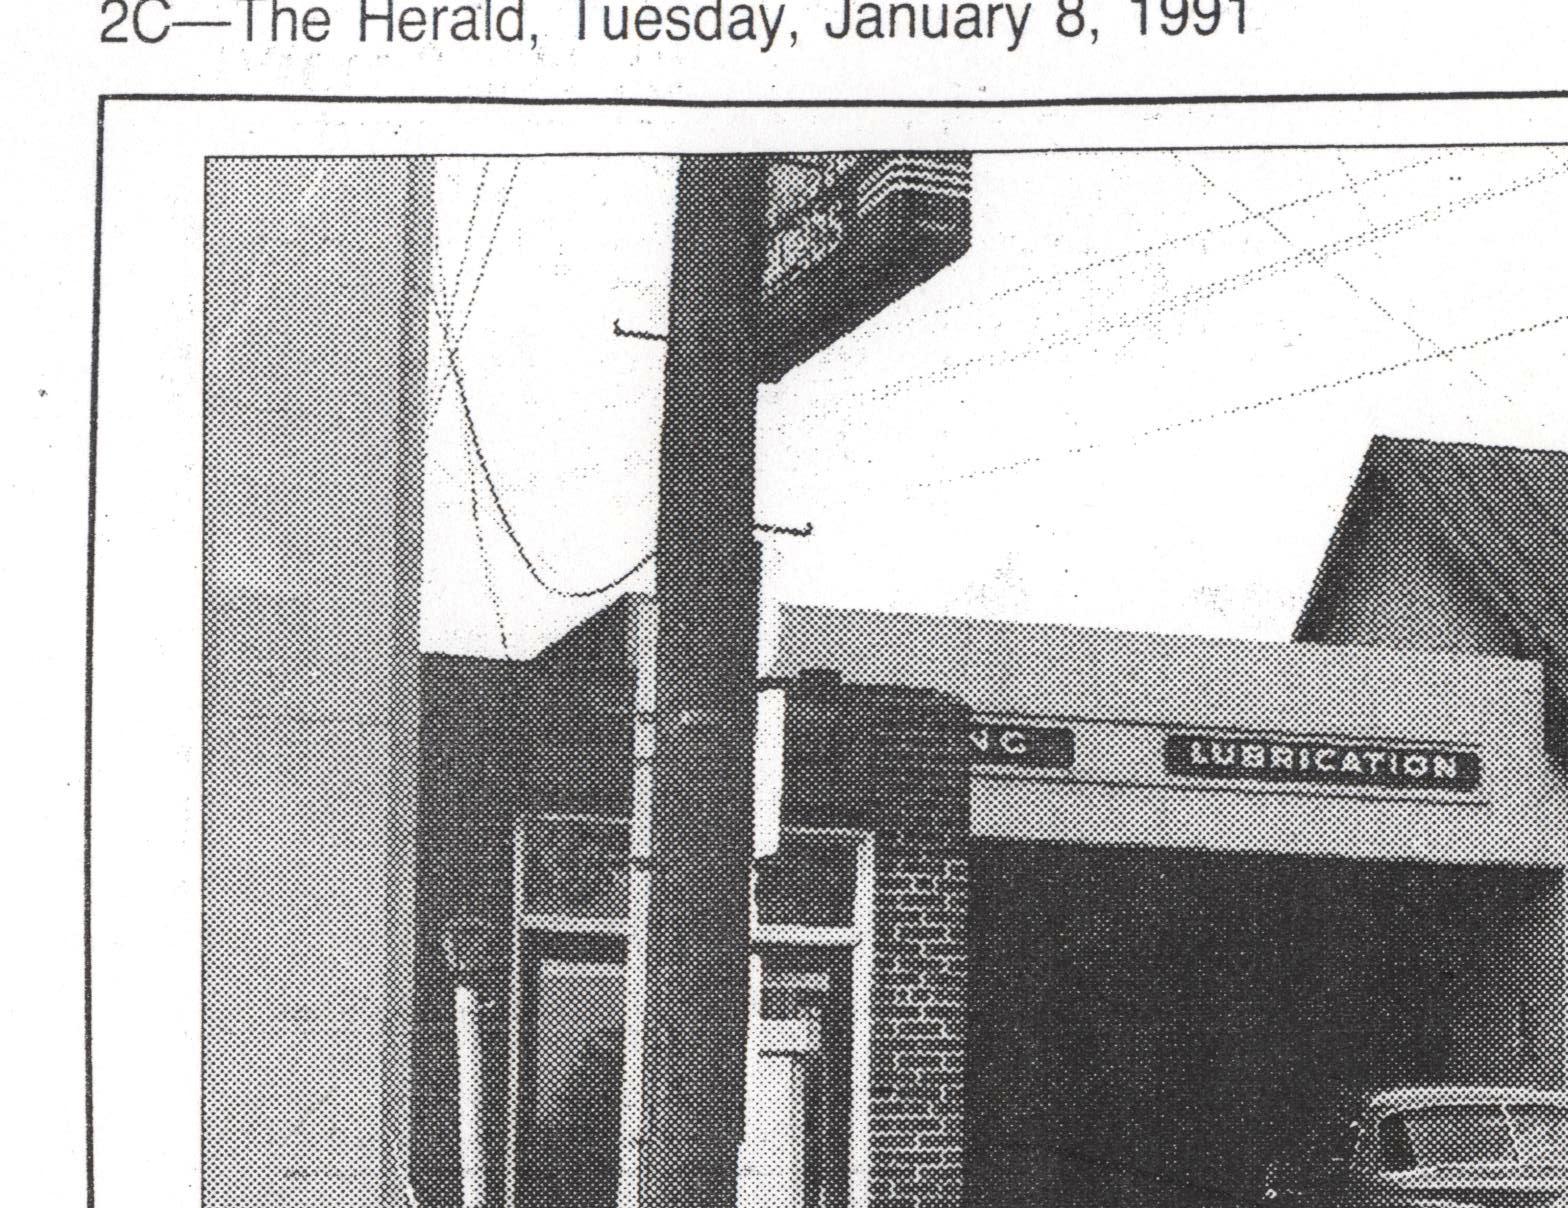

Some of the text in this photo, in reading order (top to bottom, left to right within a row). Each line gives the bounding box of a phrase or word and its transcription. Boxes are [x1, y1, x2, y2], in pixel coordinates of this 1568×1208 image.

[360, 0, 537, 50] Herald,
[578, 0, 797, 53] Tuesday,
[825, 0, 1032, 52] January
[1056, 0, 1098, 44] 8,
[1131, 0, 1245, 36] 1991
[1190, 740, 1459, 779] LUBRICATION
